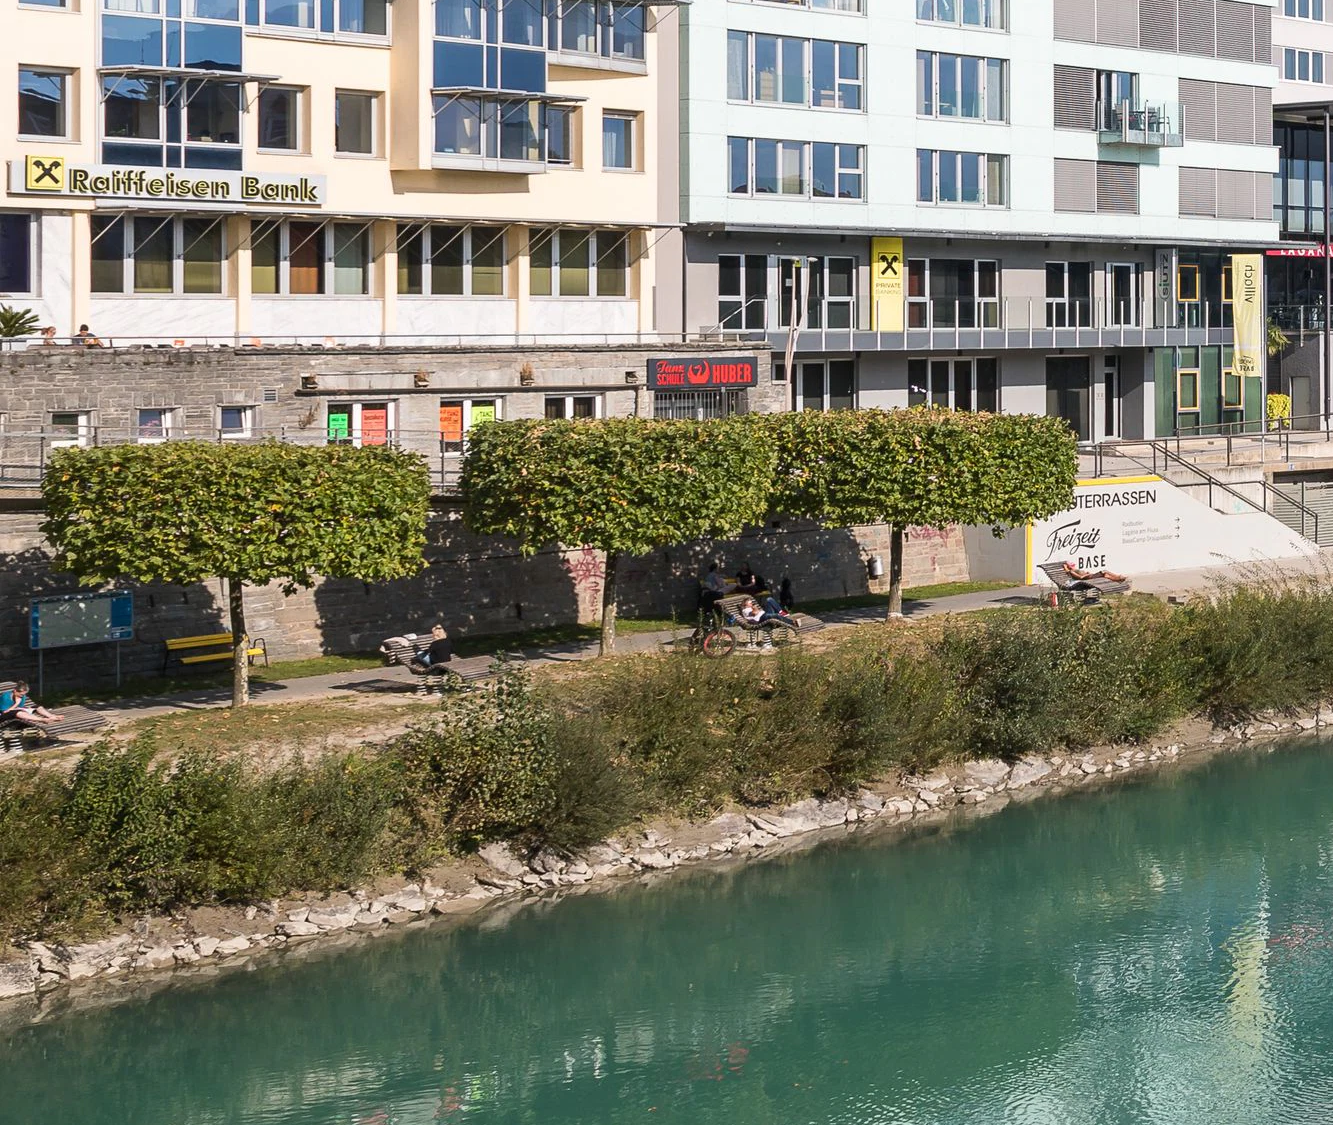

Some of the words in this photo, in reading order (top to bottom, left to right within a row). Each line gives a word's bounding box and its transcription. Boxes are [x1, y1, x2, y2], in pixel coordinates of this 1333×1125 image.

[69, 168, 230, 198] Raiffeisen
[241, 175, 318, 201] Bank
[656, 360, 685, 373] Tanz
[712, 363, 753, 384] HUBER
[656, 373, 685, 386] SCHULE
[1045, 519, 1100, 561] Freizeit
[1078, 555, 1106, 569] BASE
